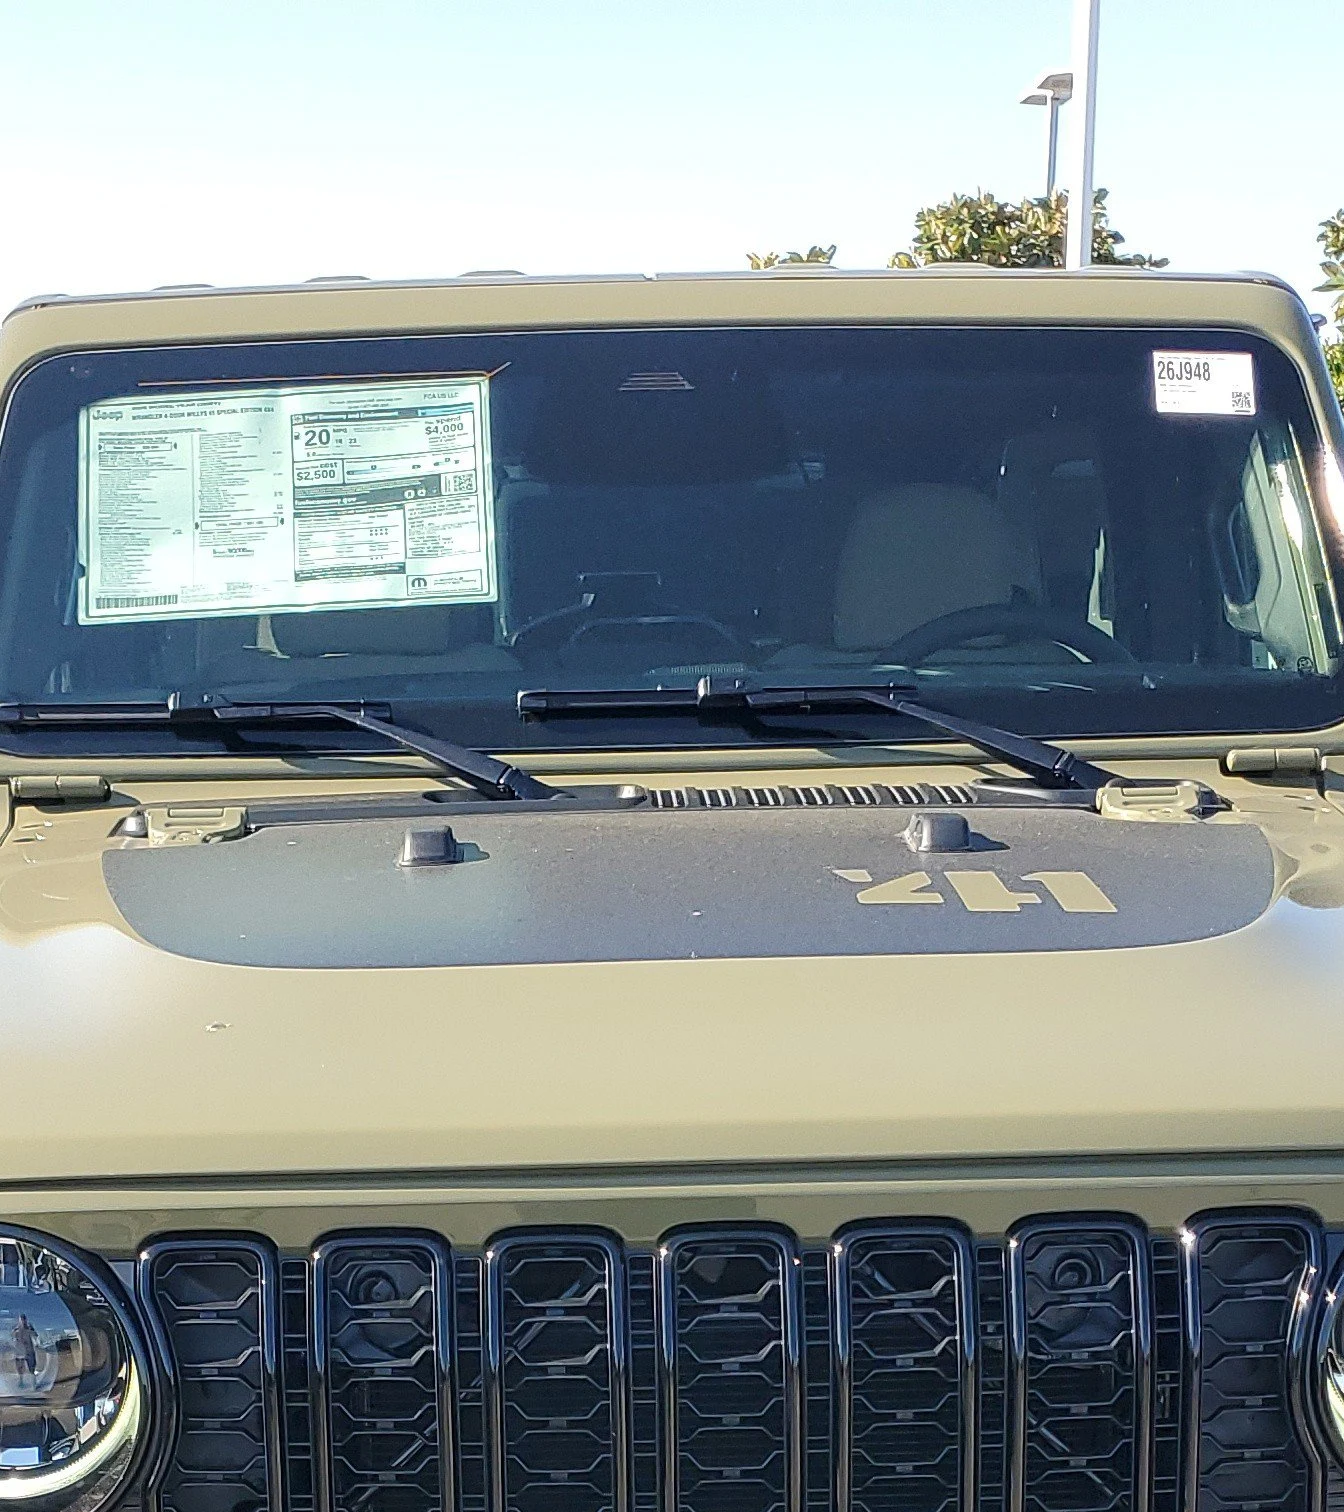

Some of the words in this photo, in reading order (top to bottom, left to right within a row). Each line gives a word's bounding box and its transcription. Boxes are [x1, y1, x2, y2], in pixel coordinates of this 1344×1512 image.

[1157, 361, 1211, 382] 26J948
[424, 422, 464, 435] $4,000
[304, 428, 331, 447] 20
[296, 469, 336, 481] $2,500
